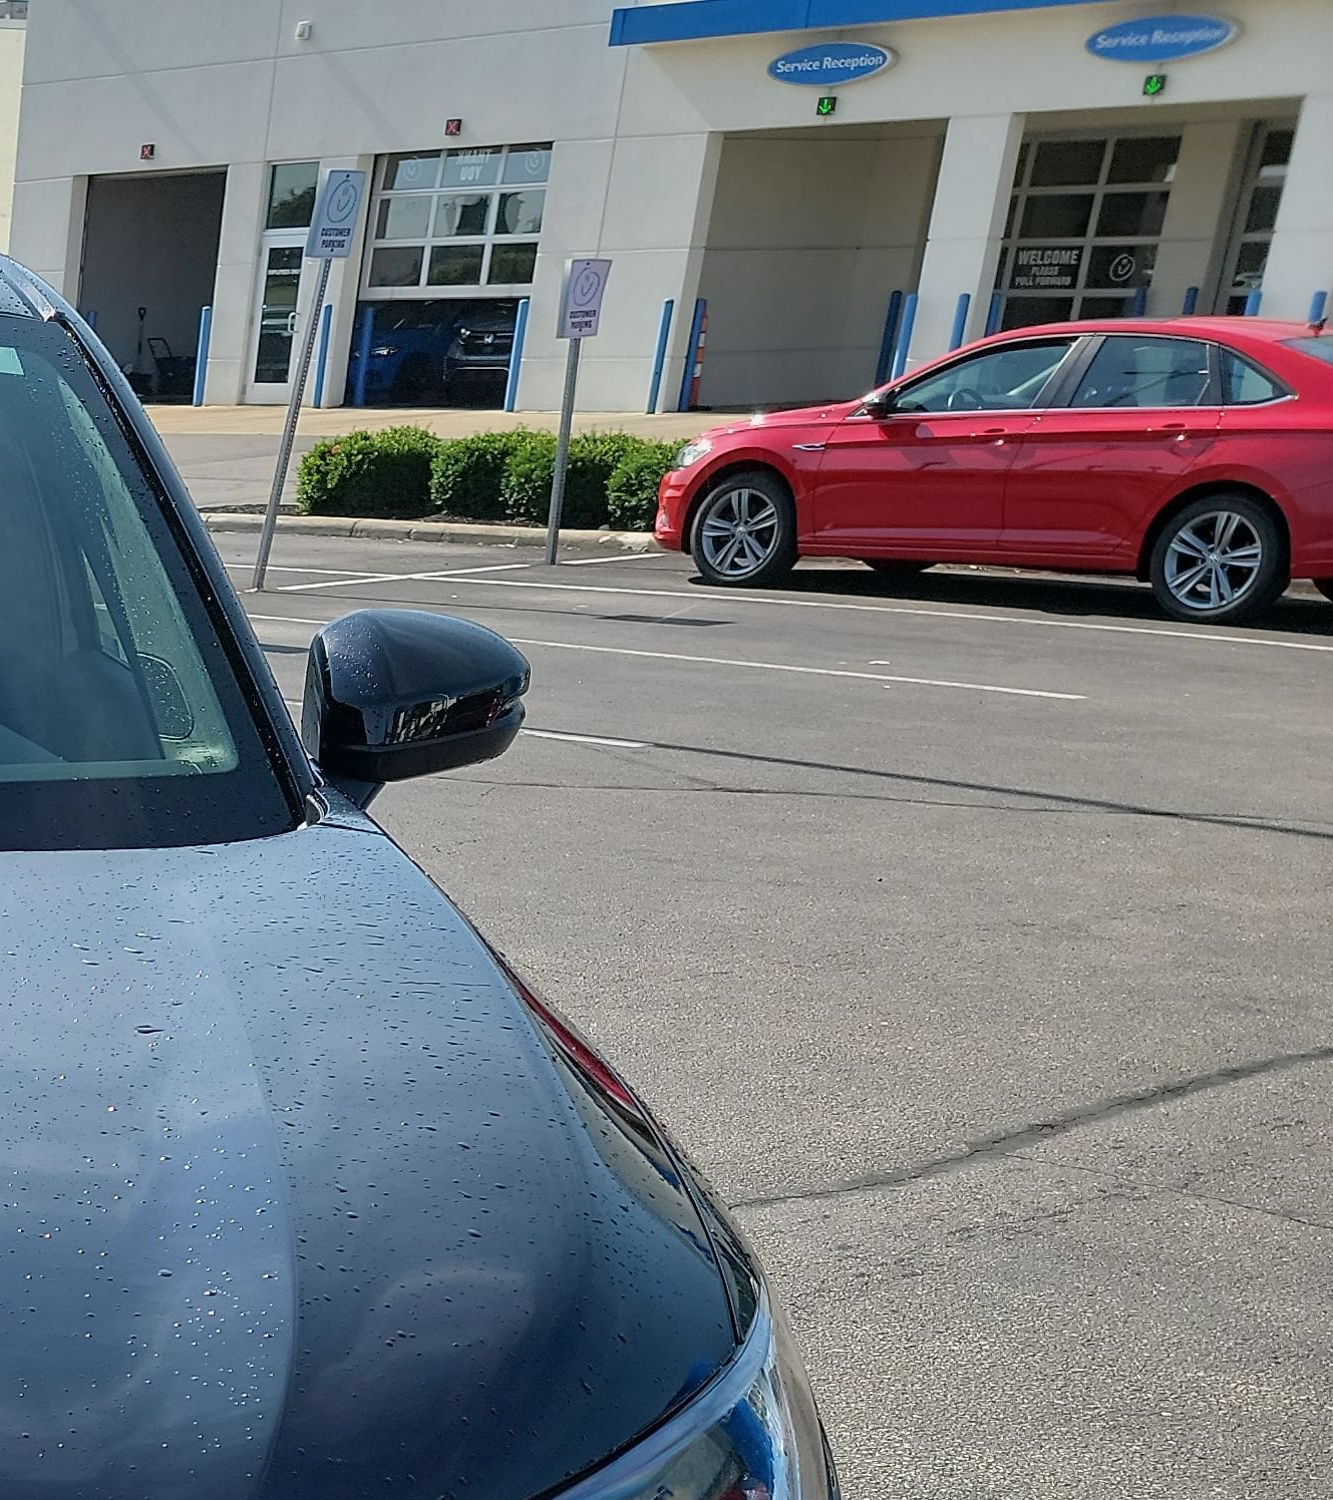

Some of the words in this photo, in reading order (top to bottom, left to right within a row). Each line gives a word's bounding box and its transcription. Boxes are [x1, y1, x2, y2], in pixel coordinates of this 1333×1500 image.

[1095, 33, 1148, 48] Service
[1151, 27, 1221, 45] Reception
[776, 60, 820, 73] Service
[822, 54, 884, 70] Reception
[1018, 250, 1080, 265] WELCOME
